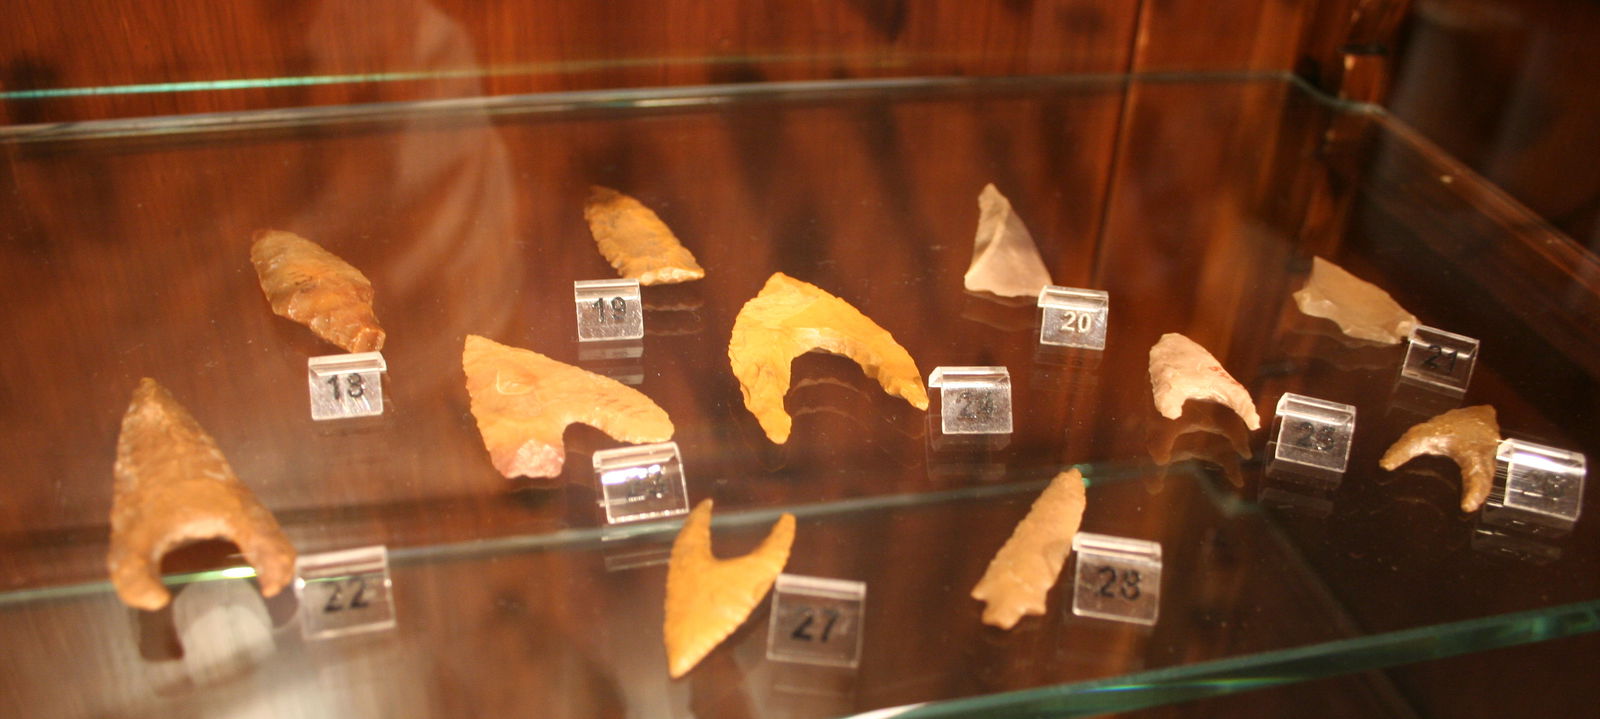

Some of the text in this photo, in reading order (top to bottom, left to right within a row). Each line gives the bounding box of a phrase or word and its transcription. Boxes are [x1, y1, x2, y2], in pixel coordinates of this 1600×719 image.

[592, 296, 627, 323] 19
[1060, 310, 1092, 334] 20
[1421, 344, 1458, 374] 21
[327, 372, 364, 400] 18
[323, 579, 369, 613] 22
[1095, 565, 1142, 601] 28
[790, 608, 840, 643] 27
